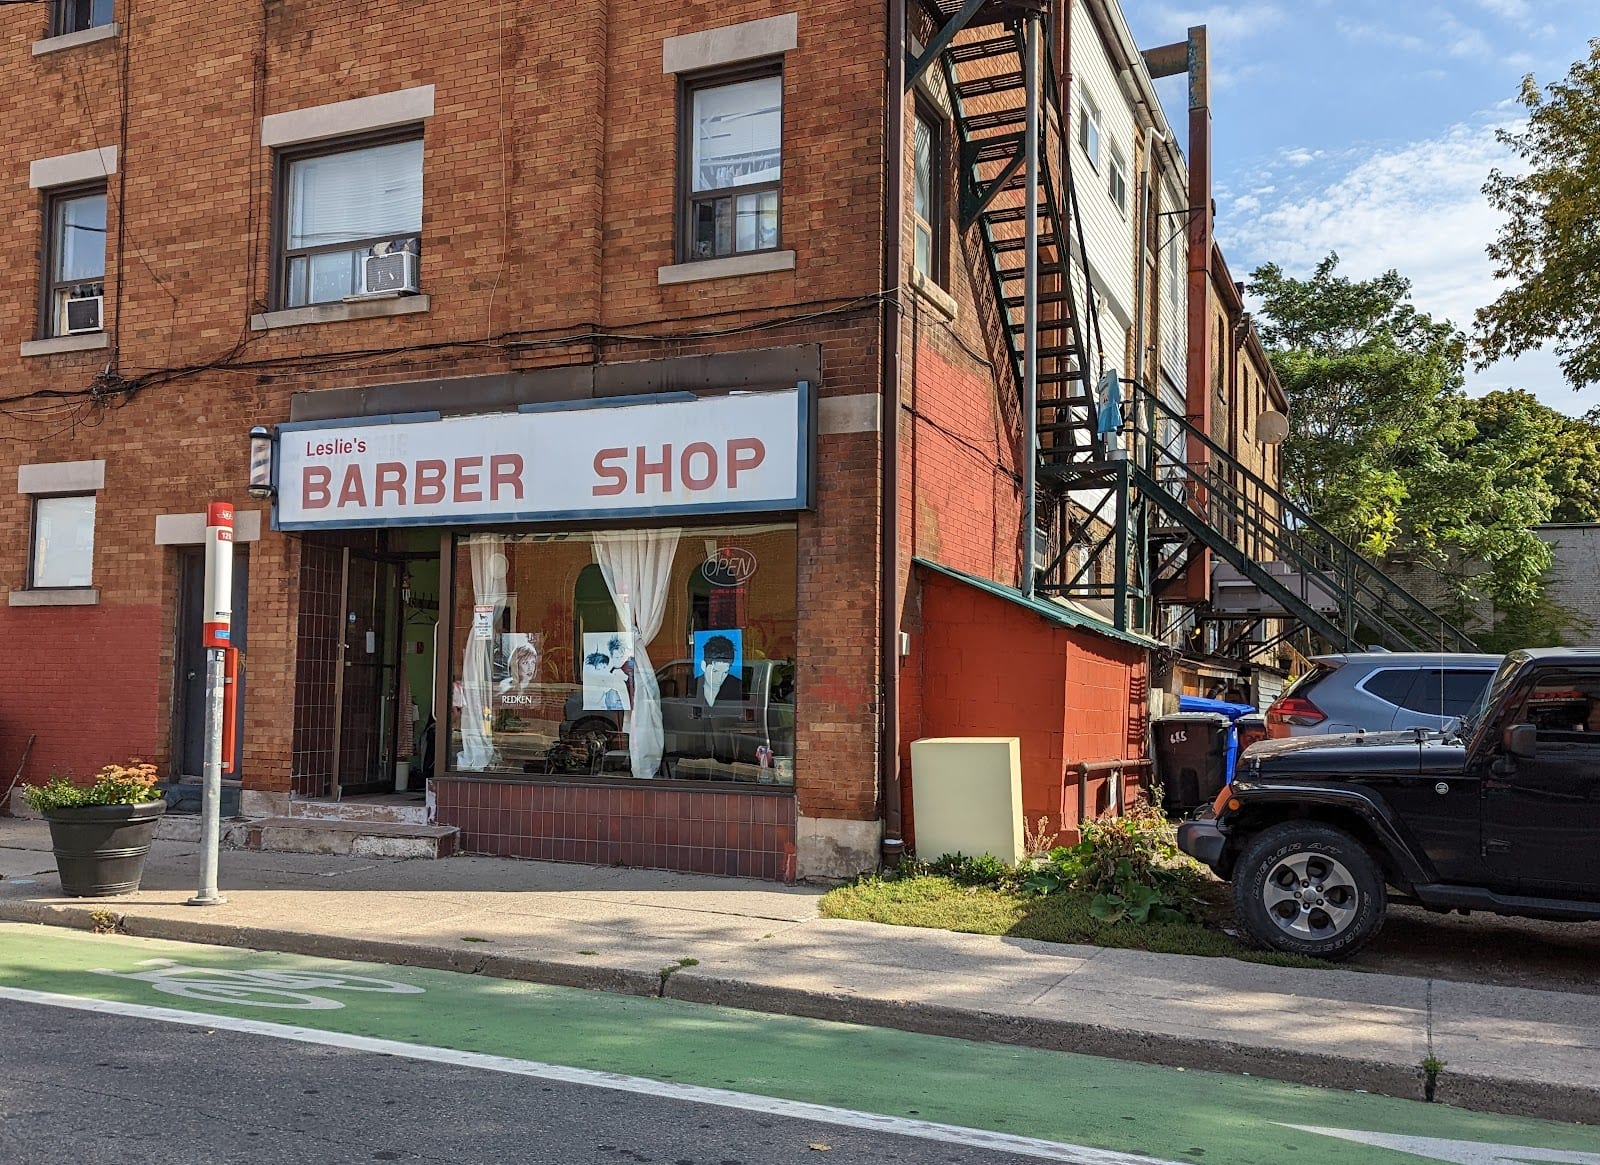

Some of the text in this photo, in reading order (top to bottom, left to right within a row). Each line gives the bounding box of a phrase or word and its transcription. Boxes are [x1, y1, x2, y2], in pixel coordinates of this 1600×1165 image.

[306, 437, 367, 457] Leslie's
[302, 437, 766, 510] BARBER SHOP
[704, 557, 752, 577] OPEN
[501, 695, 532, 704] REDKEN
